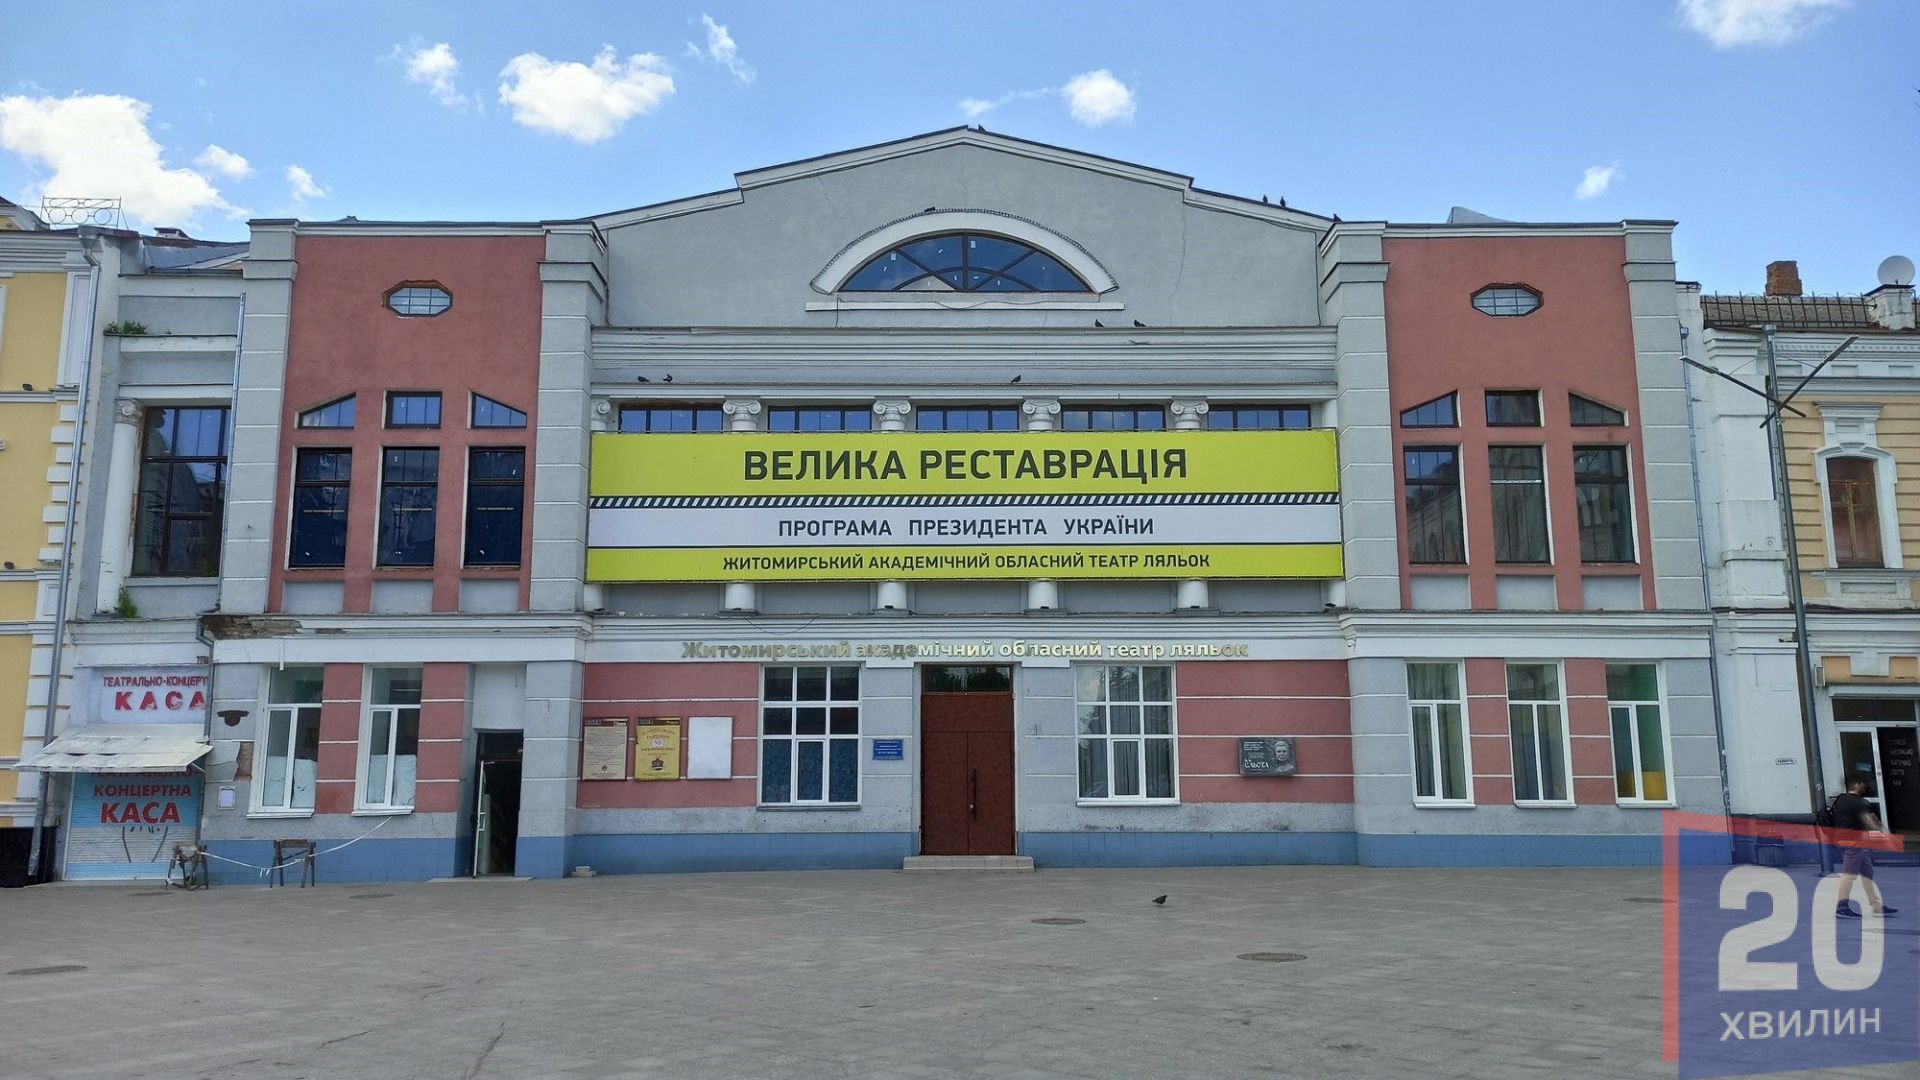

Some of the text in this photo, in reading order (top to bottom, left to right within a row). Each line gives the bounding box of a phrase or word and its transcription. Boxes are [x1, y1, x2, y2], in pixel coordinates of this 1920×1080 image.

[744, 448, 1187, 485] ВЕЛИКА РЕСТАВРАЦІЯ
[778, 514, 1154, 539] ПРОГРАМА ПРЕЗИДЕНТА УКРАЇНИ
[723, 552, 1211, 572] ЖИТОМИРСЬКИЙ АКАДЕМІЧНИЙ ОБЛАСНИЙ ТЕАТР ЛЯЛЬОК
[681, 640, 1249, 661] Житомирський академічний обласний театр ляльок
[115, 690, 208, 711] КАСА
[93, 783, 192, 798] КОНЦЕРТНА
[100, 801, 180, 824] КАСА
